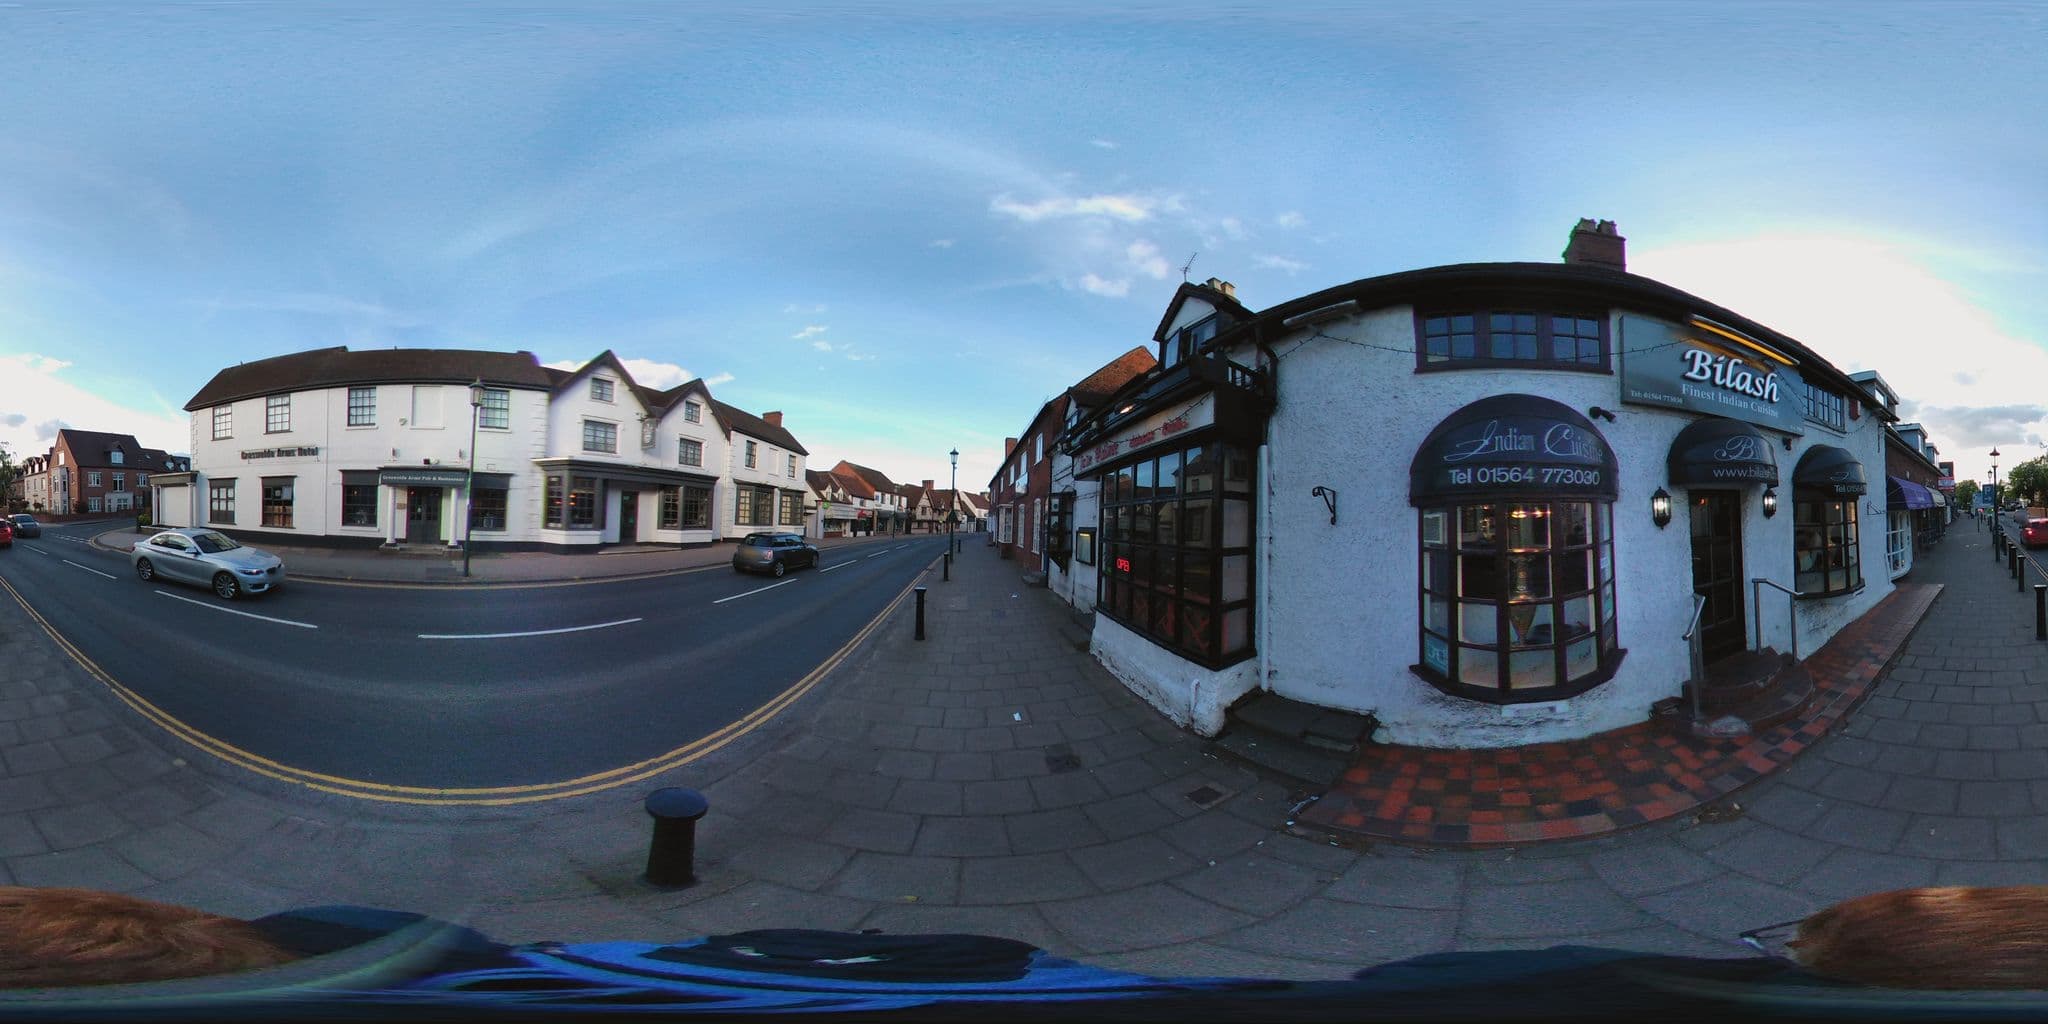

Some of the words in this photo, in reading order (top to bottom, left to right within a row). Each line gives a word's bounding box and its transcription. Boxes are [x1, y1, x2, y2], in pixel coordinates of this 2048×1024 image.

[1684, 349, 1780, 403] Bilash
[1681, 383, 1716, 400] Finest
[1718, 393, 1749, 409] Indian
[1750, 401, 1779, 418] Cuisine
[276, 448, 296, 458] Arms
[298, 446, 318, 457] Hotel
[1443, 419, 1536, 462] Indian
[1543, 423, 1603, 464] Cuisine
[1448, 467, 1472, 485] Tel
[1476, 467, 1535, 484] 01564
[1541, 468, 1601, 486] 773030
